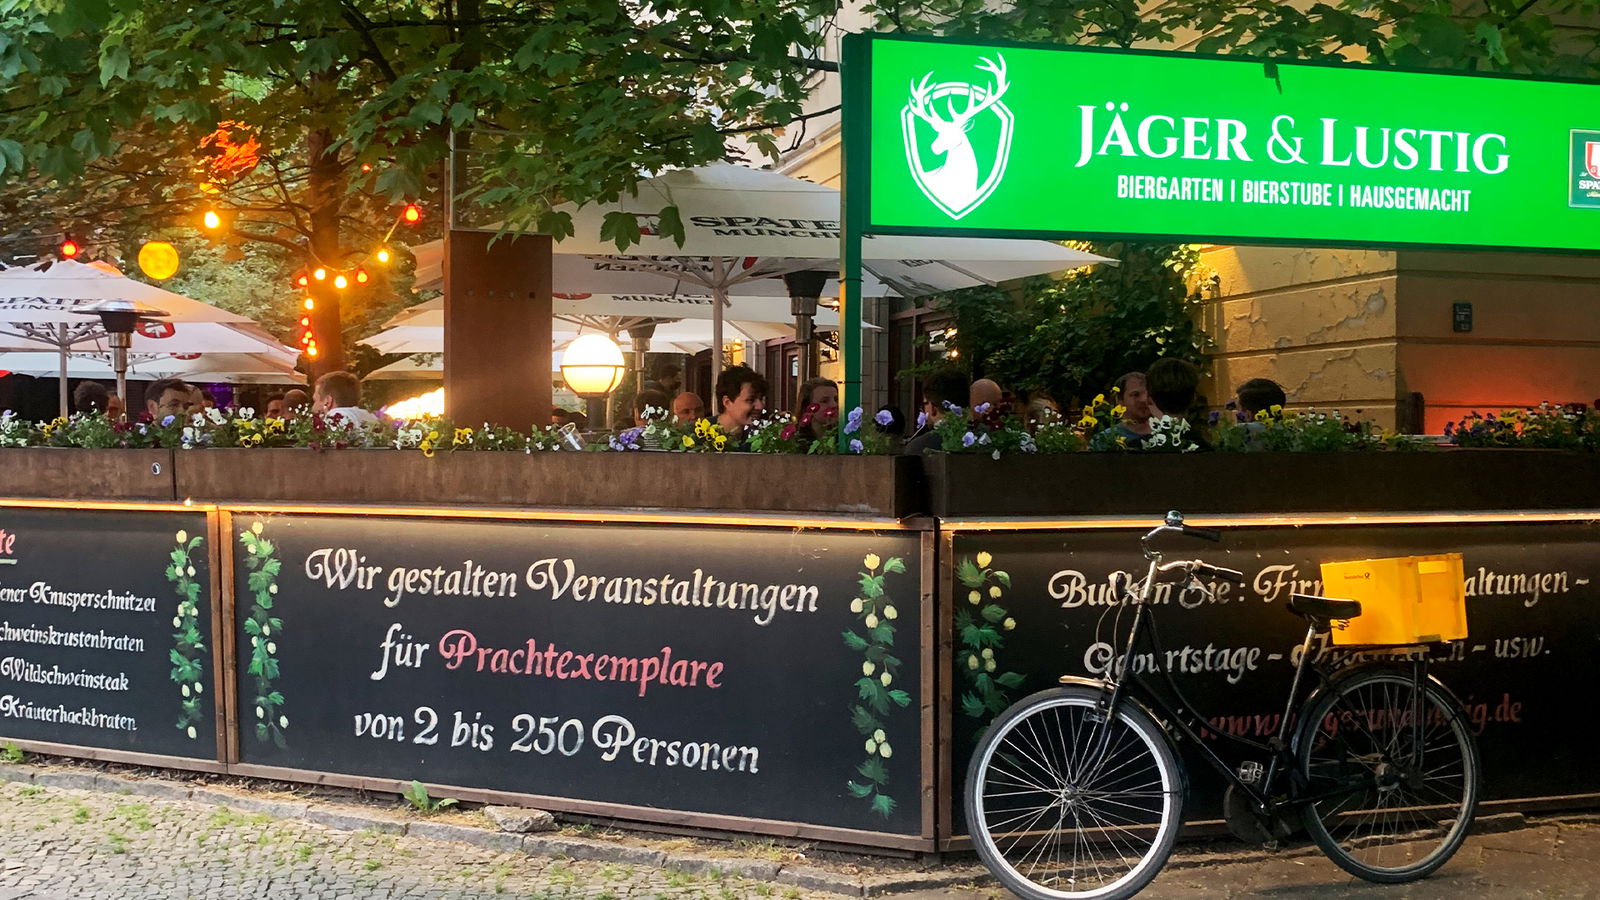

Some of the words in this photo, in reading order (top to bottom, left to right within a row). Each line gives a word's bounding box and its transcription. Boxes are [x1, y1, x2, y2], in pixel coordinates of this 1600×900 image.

[1074, 101, 1253, 168] JÄGER
[1266, 114, 1308, 164] &
[1320, 117, 1510, 174] LUSTIG
[1117, 174, 1223, 202] BIERGARTEN
[1242, 179, 1332, 206] BIERSTUBE
[1350, 184, 1472, 212] HAUSGEMACHT
[690, 215, 840, 231] SPATE
[29, 581, 157, 613] Knusperschnitzel
[305, 547, 381, 590] Wir
[384, 559, 517, 608] gestalten
[526, 558, 819, 626] Veranstaltungen
[370, 622, 430, 681] für
[438, 629, 724, 697] Prachtexemplare
[1494, 636, 1551, 658] usw.
[0, 656, 129, 691] Wildschweinsteak
[353, 711, 405, 743] von
[412, 706, 439, 746] 2
[451, 711, 495, 752] bis
[509, 713, 585, 757] 250
[592, 714, 759, 774] Personen
